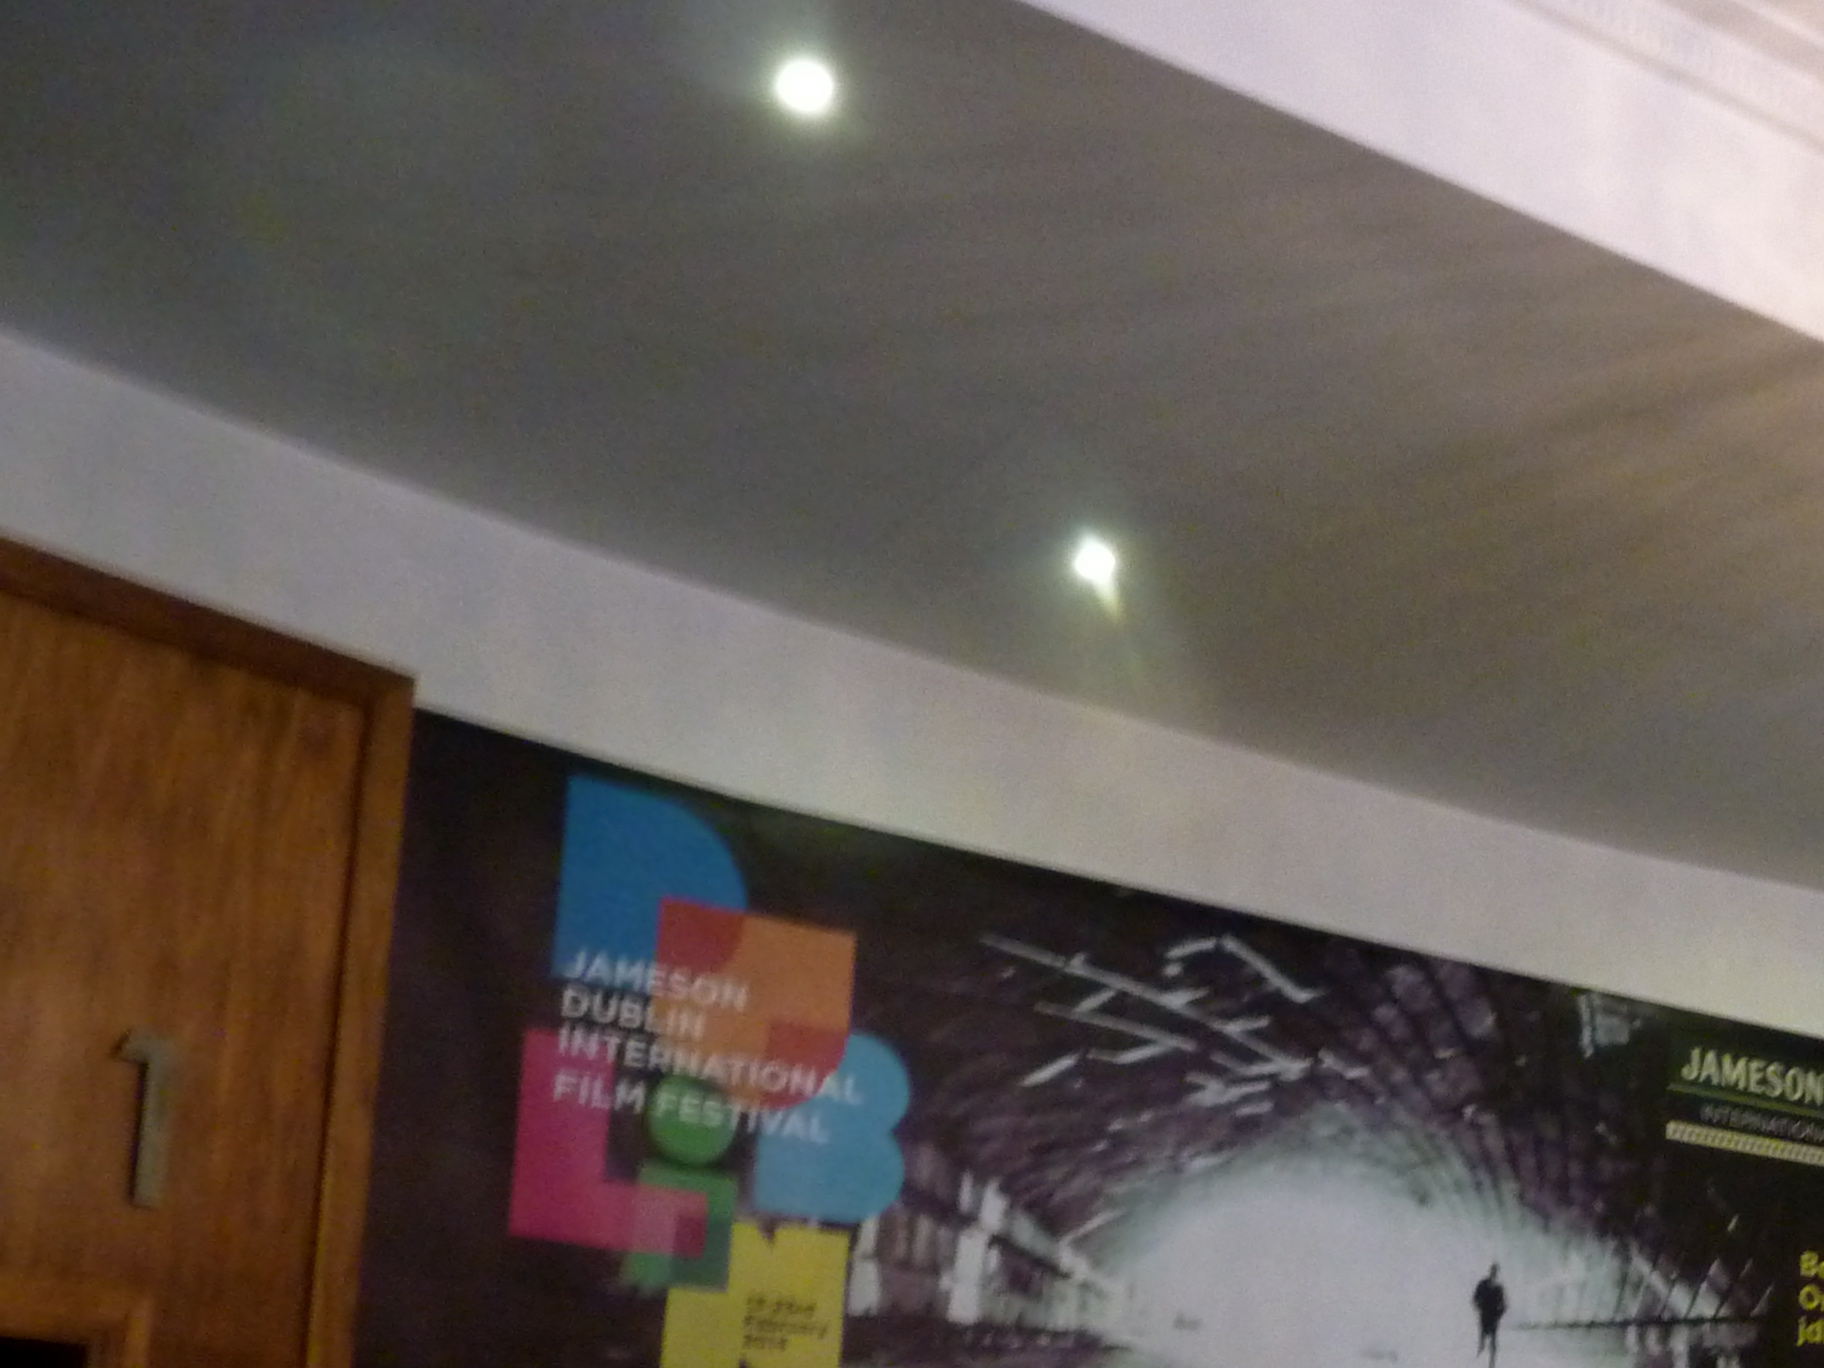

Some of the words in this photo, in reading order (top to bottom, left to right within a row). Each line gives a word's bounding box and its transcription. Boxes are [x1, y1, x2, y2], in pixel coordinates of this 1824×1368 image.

[561, 982, 706, 1040] DUBLIN
[564, 950, 748, 1012] JAMESON
[558, 1022, 863, 1106] INTERNATIONAL
[1681, 1047, 1824, 1107] JAMESON
[553, 1069, 647, 1114] FILM
[654, 1094, 830, 1144] FESTIVAL
